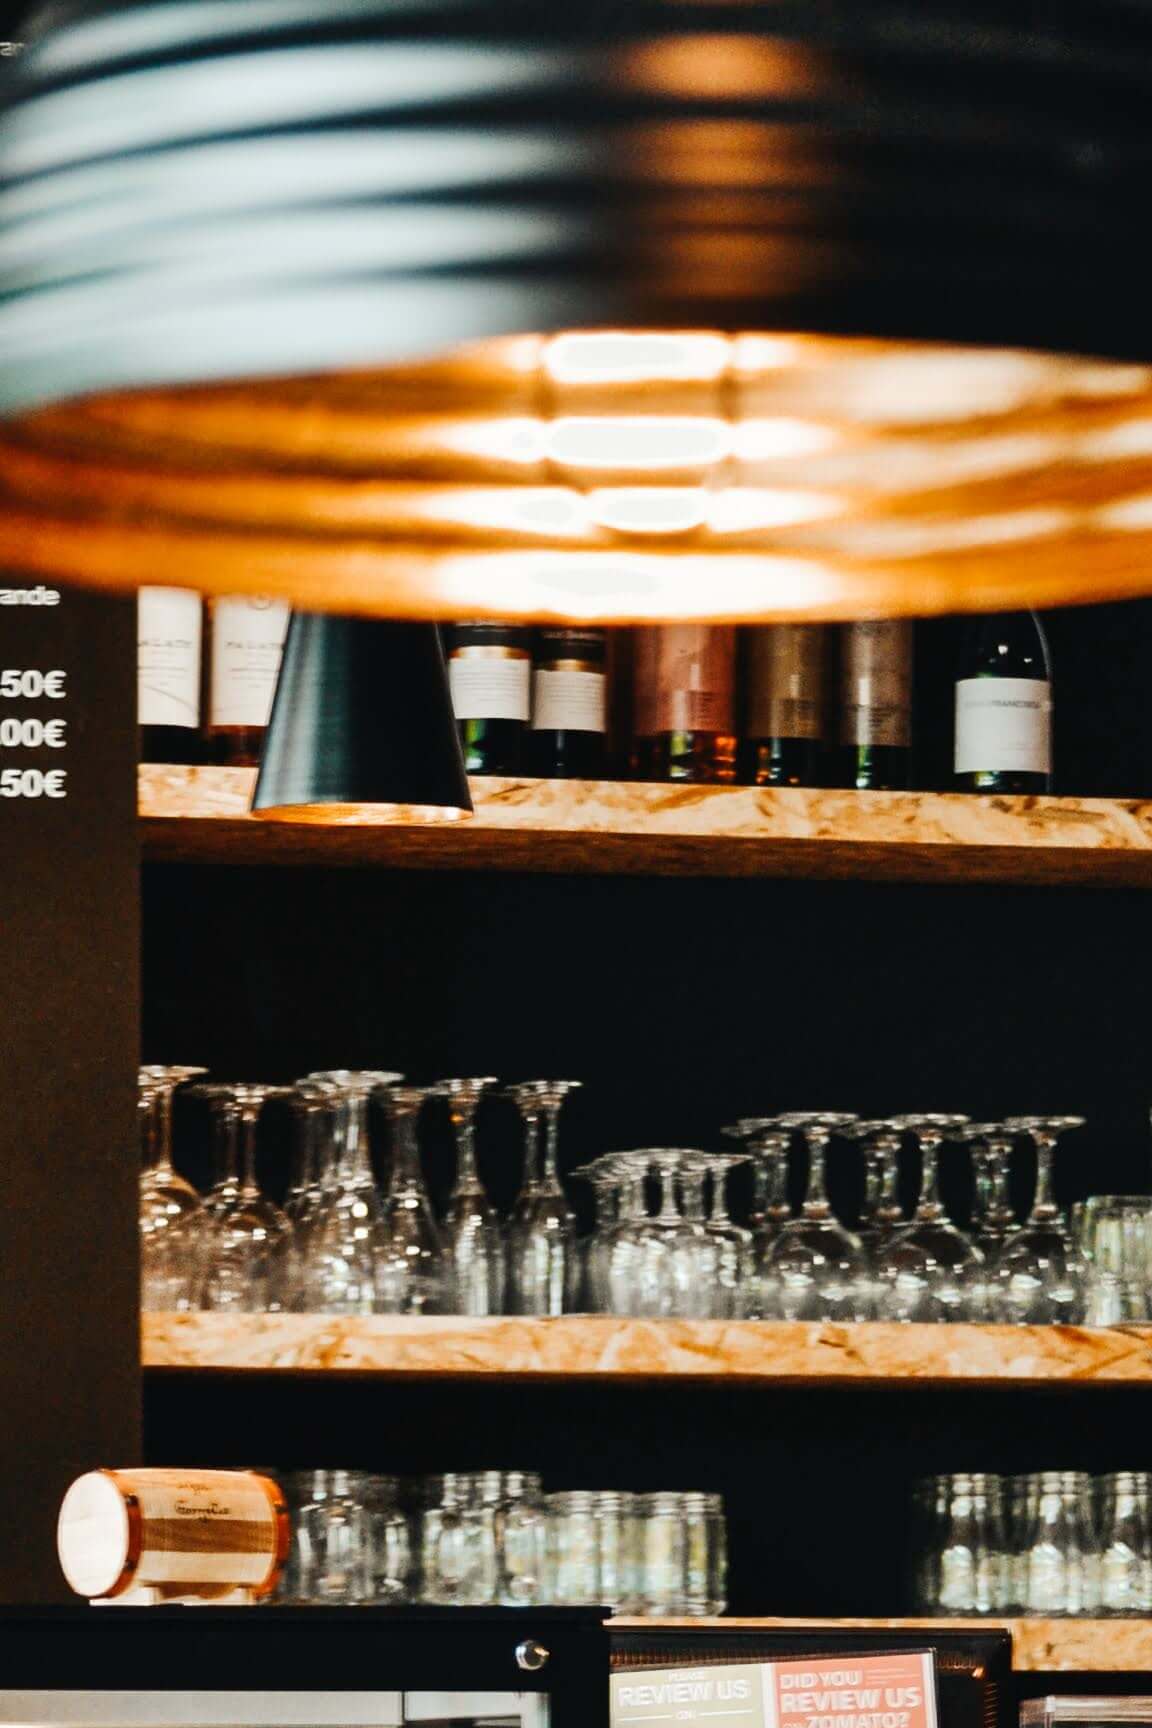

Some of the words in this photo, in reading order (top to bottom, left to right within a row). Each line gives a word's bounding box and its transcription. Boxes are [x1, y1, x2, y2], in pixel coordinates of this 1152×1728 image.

[617, 1684, 714, 1707] REVIEW
[717, 1679, 753, 1700] US
[779, 1672, 818, 1689] DID
[821, 1670, 864, 1687] YOU
[780, 1691, 881, 1713] REVIEW
[885, 1686, 922, 1708] US
